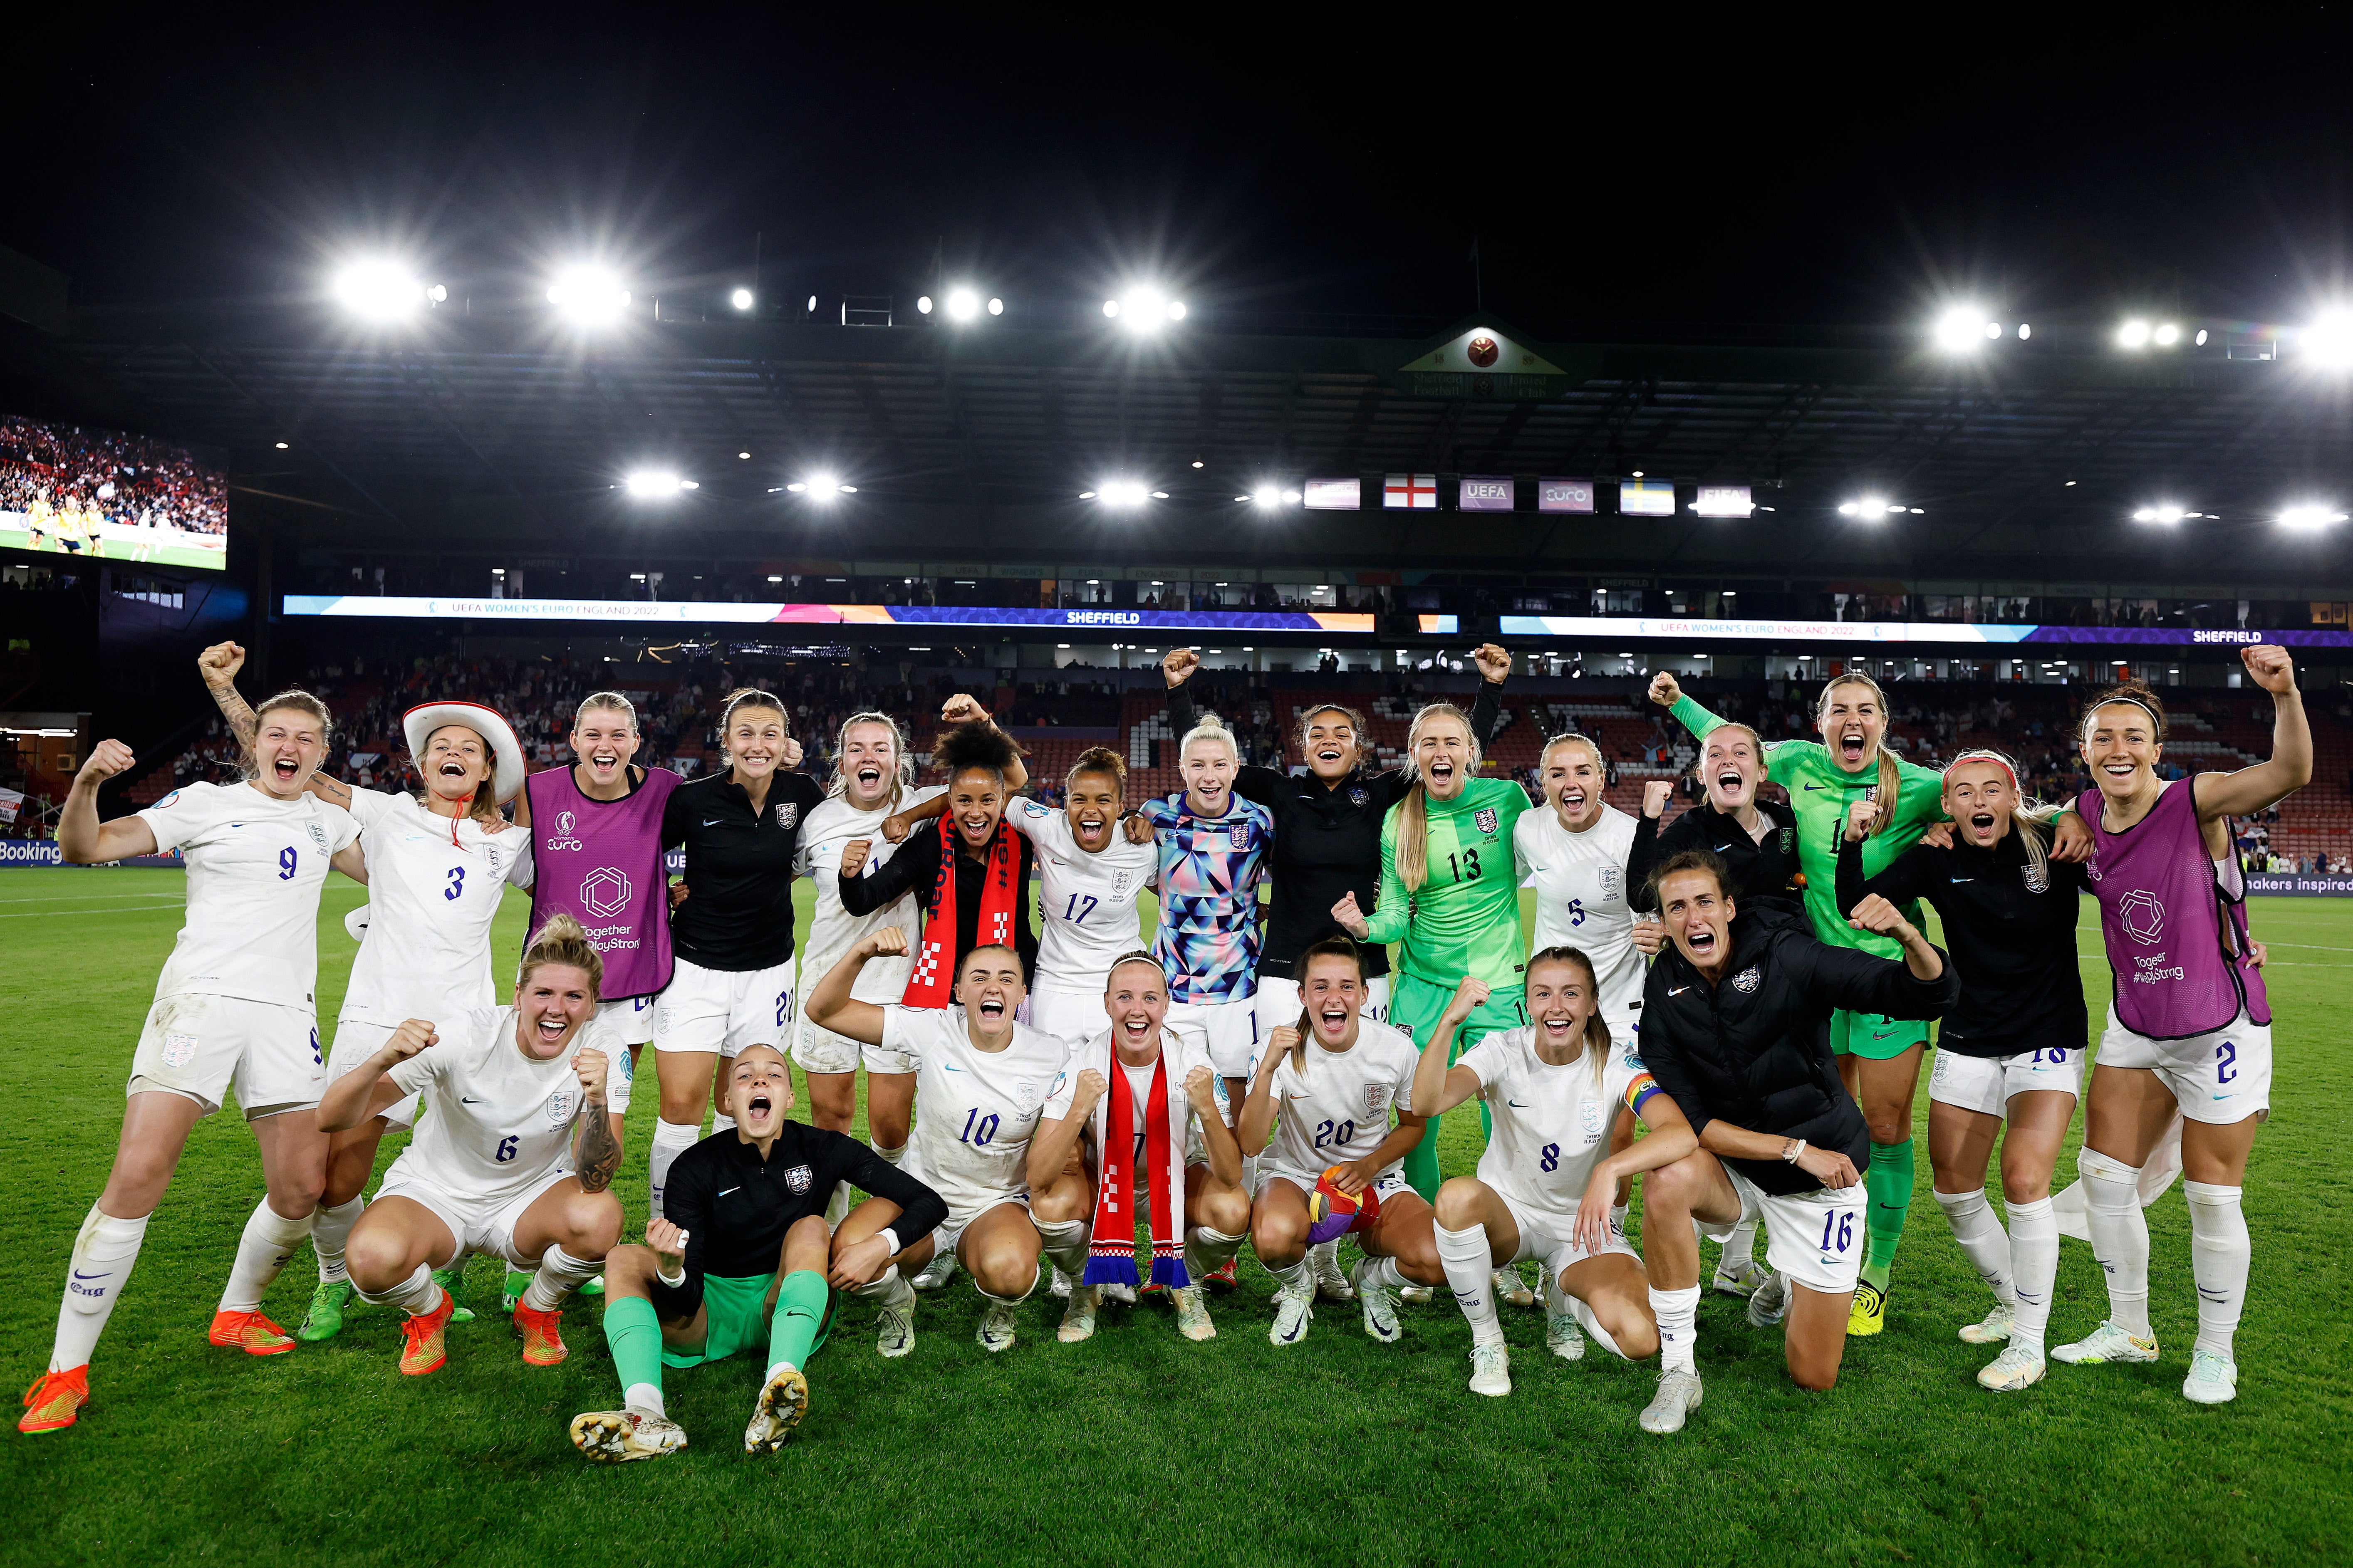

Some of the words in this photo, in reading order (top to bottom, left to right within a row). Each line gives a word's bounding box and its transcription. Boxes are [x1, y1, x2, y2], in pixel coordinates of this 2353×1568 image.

[1414, 385, 1460, 396] Football
[1519, 386, 1546, 398] Club
[1467, 485, 1506, 497] UEFA
[452, 603, 482, 613] UEFA
[485, 604, 538, 613] WOMEN'S
[542, 605, 573, 614] EURO
[577, 606, 630, 615] ENGLAND
[634, 606, 659, 615] 2022
[1067, 611, 1140, 624] SHEFFIELD
[1691, 624, 1742, 633] WOMEN'S
[1745, 625, 1774, 633] EURO
[1778, 625, 1827, 634] ENGLAND
[1831, 626, 1854, 635] 2022
[2193, 630, 2262, 643] SHEFFIELD
[1828, 818, 1842, 854] 1
[0, 841, 62, 865] Booking
[279, 846, 297, 880] 9
[1447, 847, 1481, 883] 13
[444, 866, 466, 901] 3
[1062, 893, 1098, 924] 17
[1568, 898, 1585, 927] 5
[1248, 1008, 1259, 1045] 1
[2216, 1041, 2237, 1083] 2
[1639, 1079, 1660, 1093] CA
[958, 1108, 1000, 1146] 10
[1314, 1118, 1355, 1148] 20
[495, 1134, 520, 1162] 6
[1134, 1133, 1146, 1167] 7
[1540, 1142, 1560, 1172] 8
[1819, 1209, 1854, 1253] 16
[70, 1282, 107, 1297] Eng
[1457, 1298, 1481, 1307] Eng
